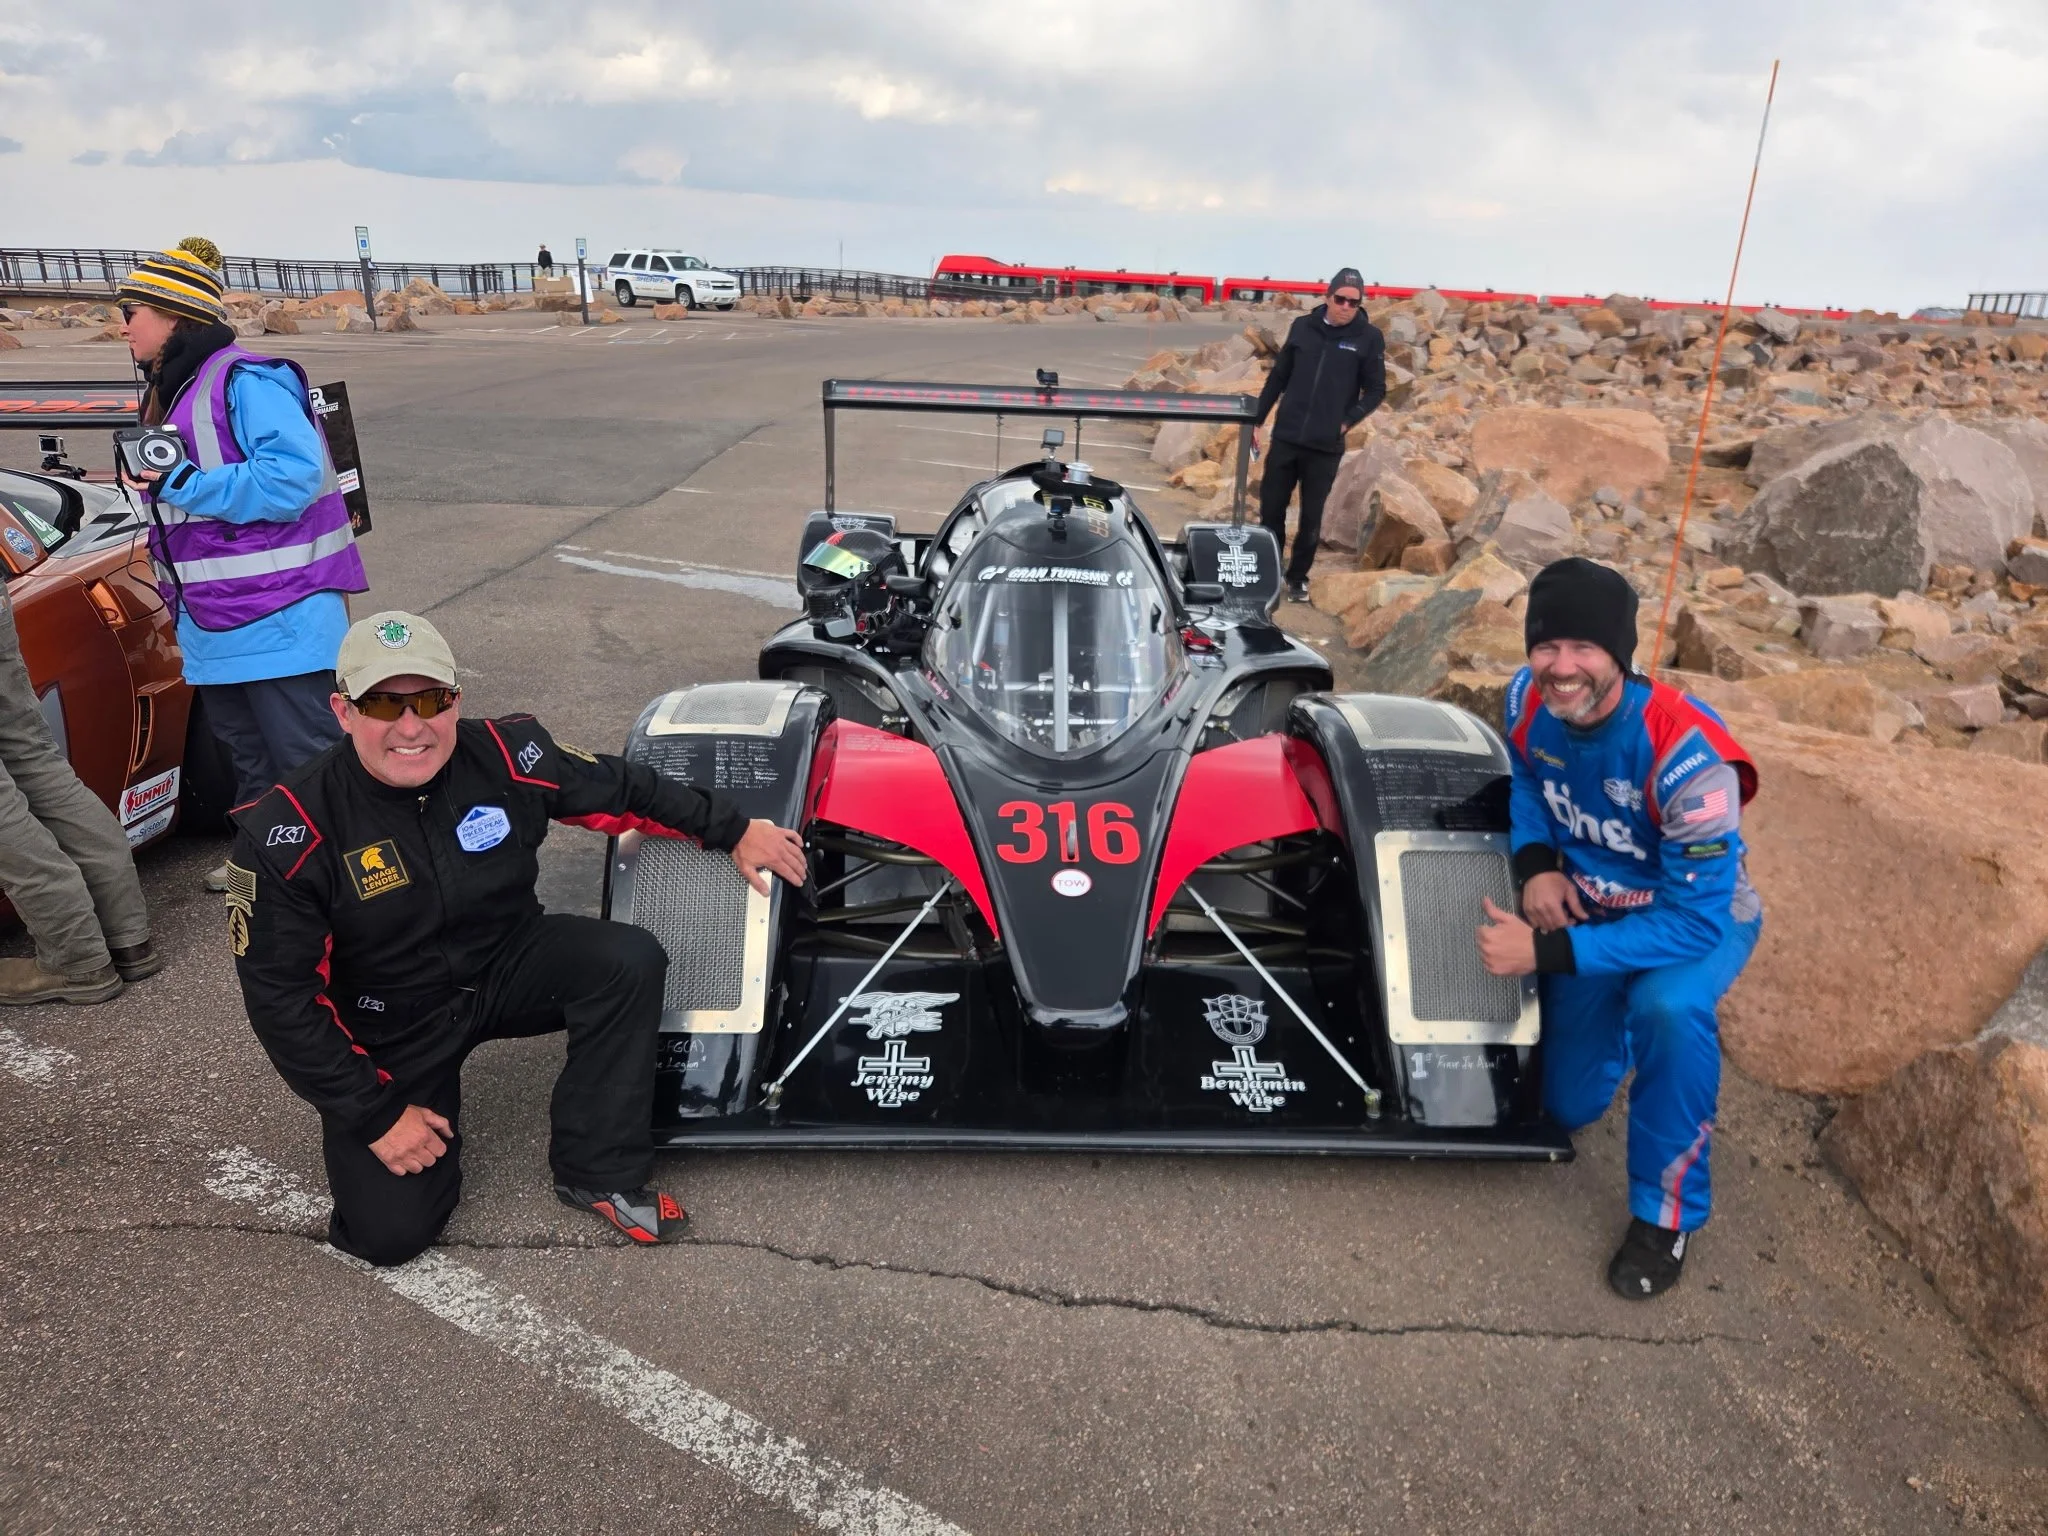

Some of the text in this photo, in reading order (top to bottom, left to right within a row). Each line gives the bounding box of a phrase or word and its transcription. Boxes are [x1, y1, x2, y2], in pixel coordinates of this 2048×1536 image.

[636, 275, 665, 284] SHERIFF
[338, 471, 358, 482] ORVETTE
[1007, 566, 1049, 580] GRAN
[1049, 566, 1111, 583] TURISMO
[1217, 563, 1258, 575] Joseph
[518, 741, 544, 773] K1
[125, 770, 176, 822] SUMMIT
[128, 817, 167, 842] ro-System
[266, 824, 307, 846] K1
[463, 826, 484, 840] PIKES
[484, 817, 504, 830] PEAK
[997, 800, 1161, 865] 316
[361, 866, 398, 885] SAVAGE
[364, 873, 400, 891] LENDER
[1056, 879, 1086, 888] TOW
[357, 995, 385, 1012] K1
[850, 1072, 935, 1089] Jeremy
[1200, 1076, 1307, 1092] Benjamin
[866, 1088, 920, 1102] Wise
[1229, 1092, 1287, 1107] Wise
